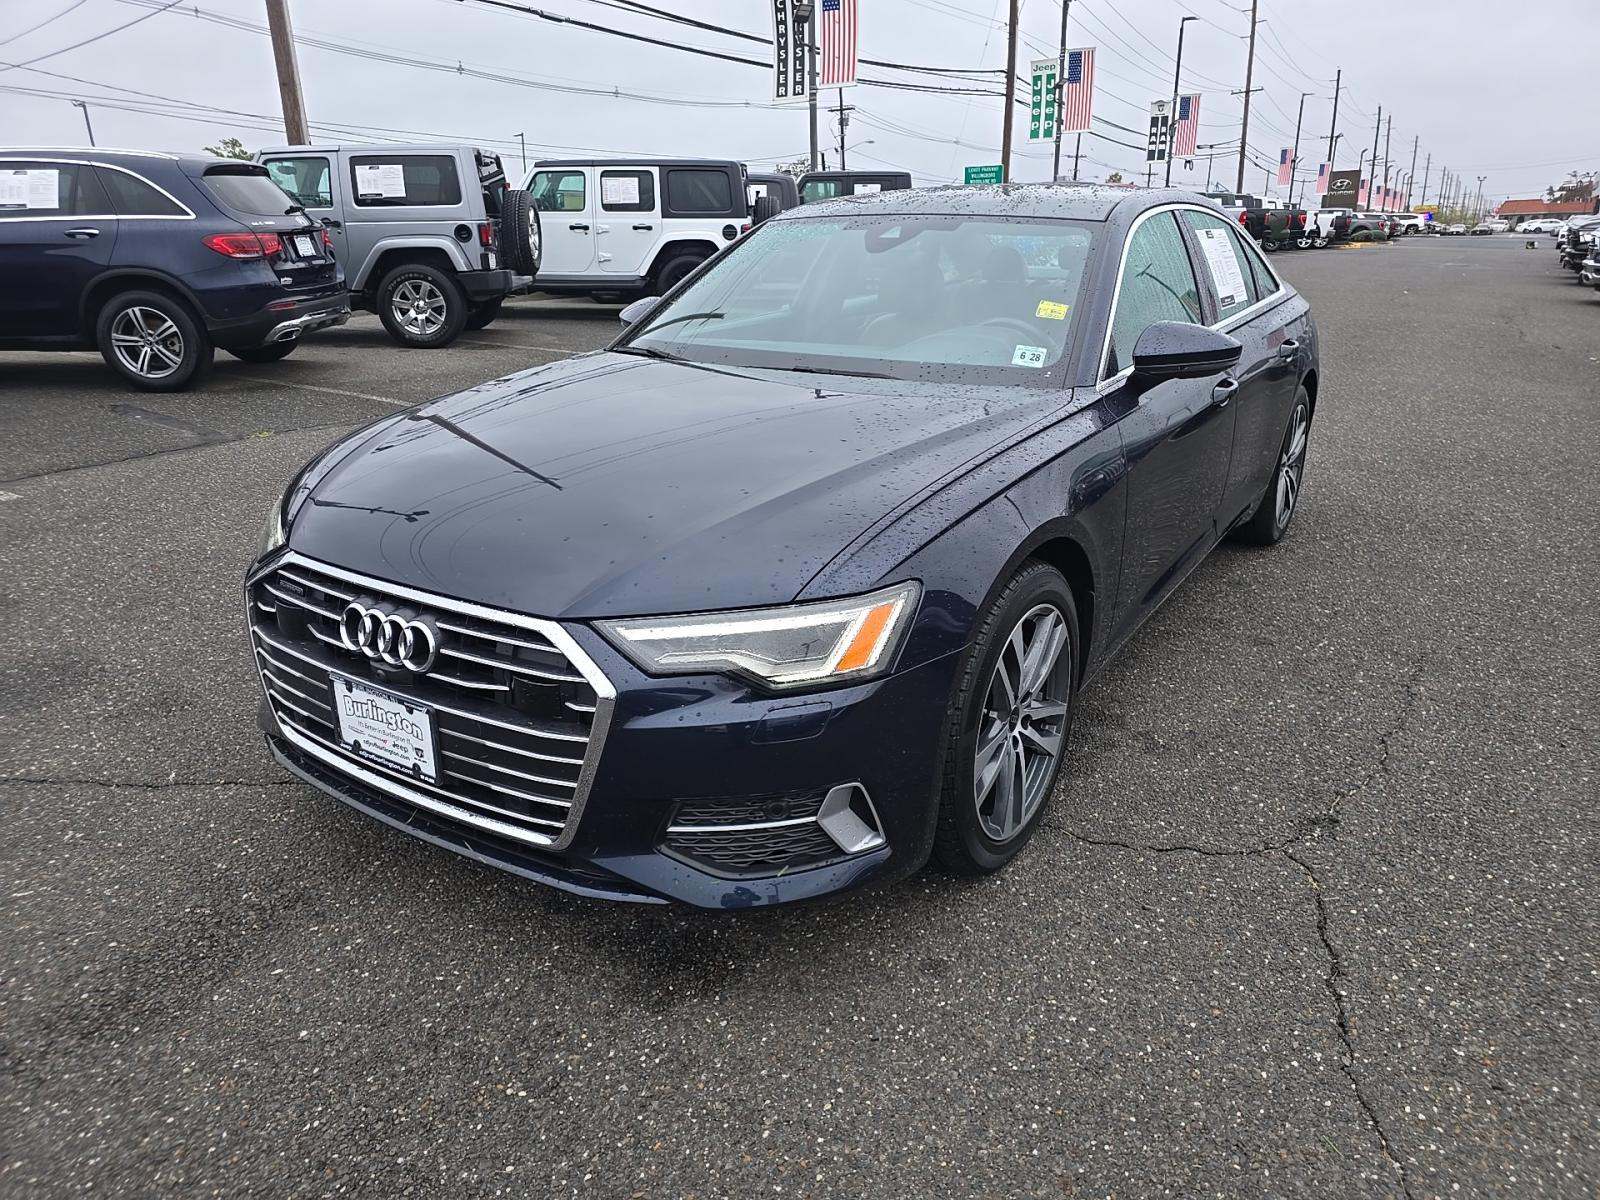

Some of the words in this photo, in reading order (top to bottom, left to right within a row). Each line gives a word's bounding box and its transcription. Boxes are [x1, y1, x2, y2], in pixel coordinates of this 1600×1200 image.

[776, 0, 786, 95] CHRYSLER
[793, 0, 803, 94] CRYSLER
[1033, 64, 1056, 72] Jeep
[1032, 81, 1041, 130] Jeep
[1045, 79, 1055, 130] Jeep
[1149, 127, 1157, 150] RAM
[1029, 353, 1041, 361] 28
[343, 695, 424, 741] Burlington
[392, 740, 408, 753] Jeep
